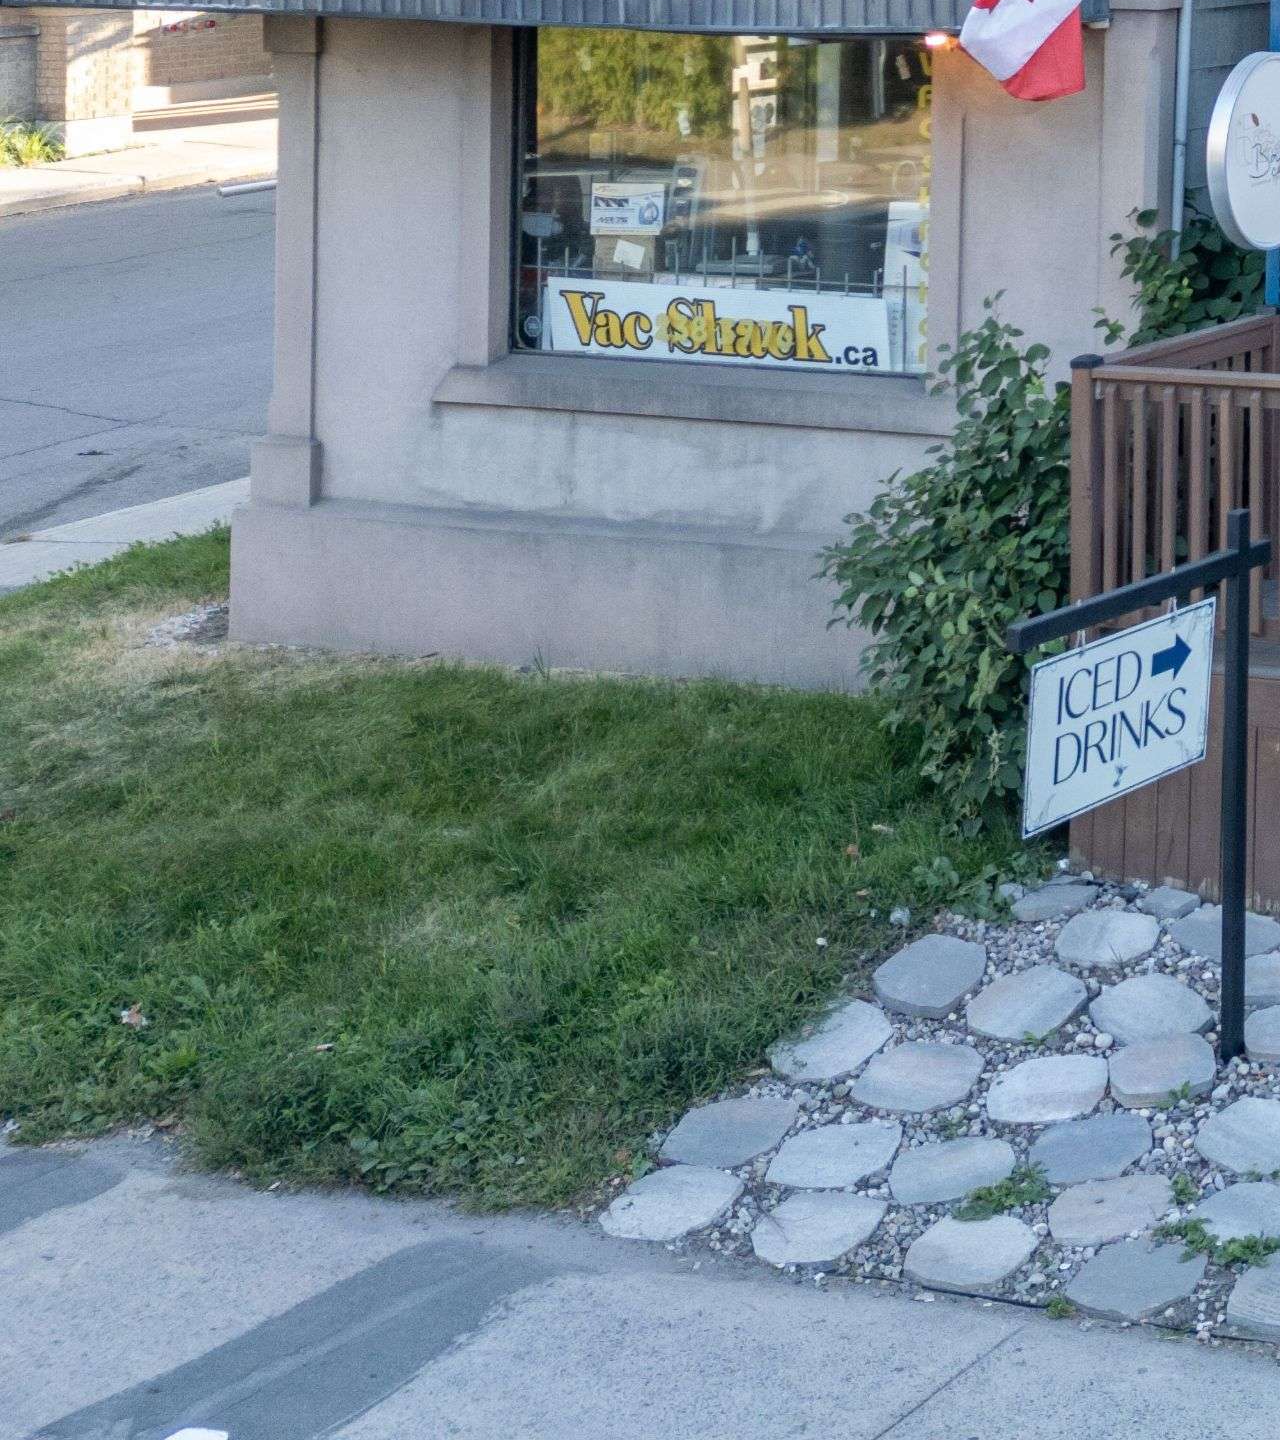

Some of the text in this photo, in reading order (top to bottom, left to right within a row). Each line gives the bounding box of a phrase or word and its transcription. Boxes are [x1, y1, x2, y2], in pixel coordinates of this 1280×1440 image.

[559, 290, 653, 350] Vac
[1057, 650, 1143, 725] ICED
[1053, 686, 1187, 786] DRINKS
